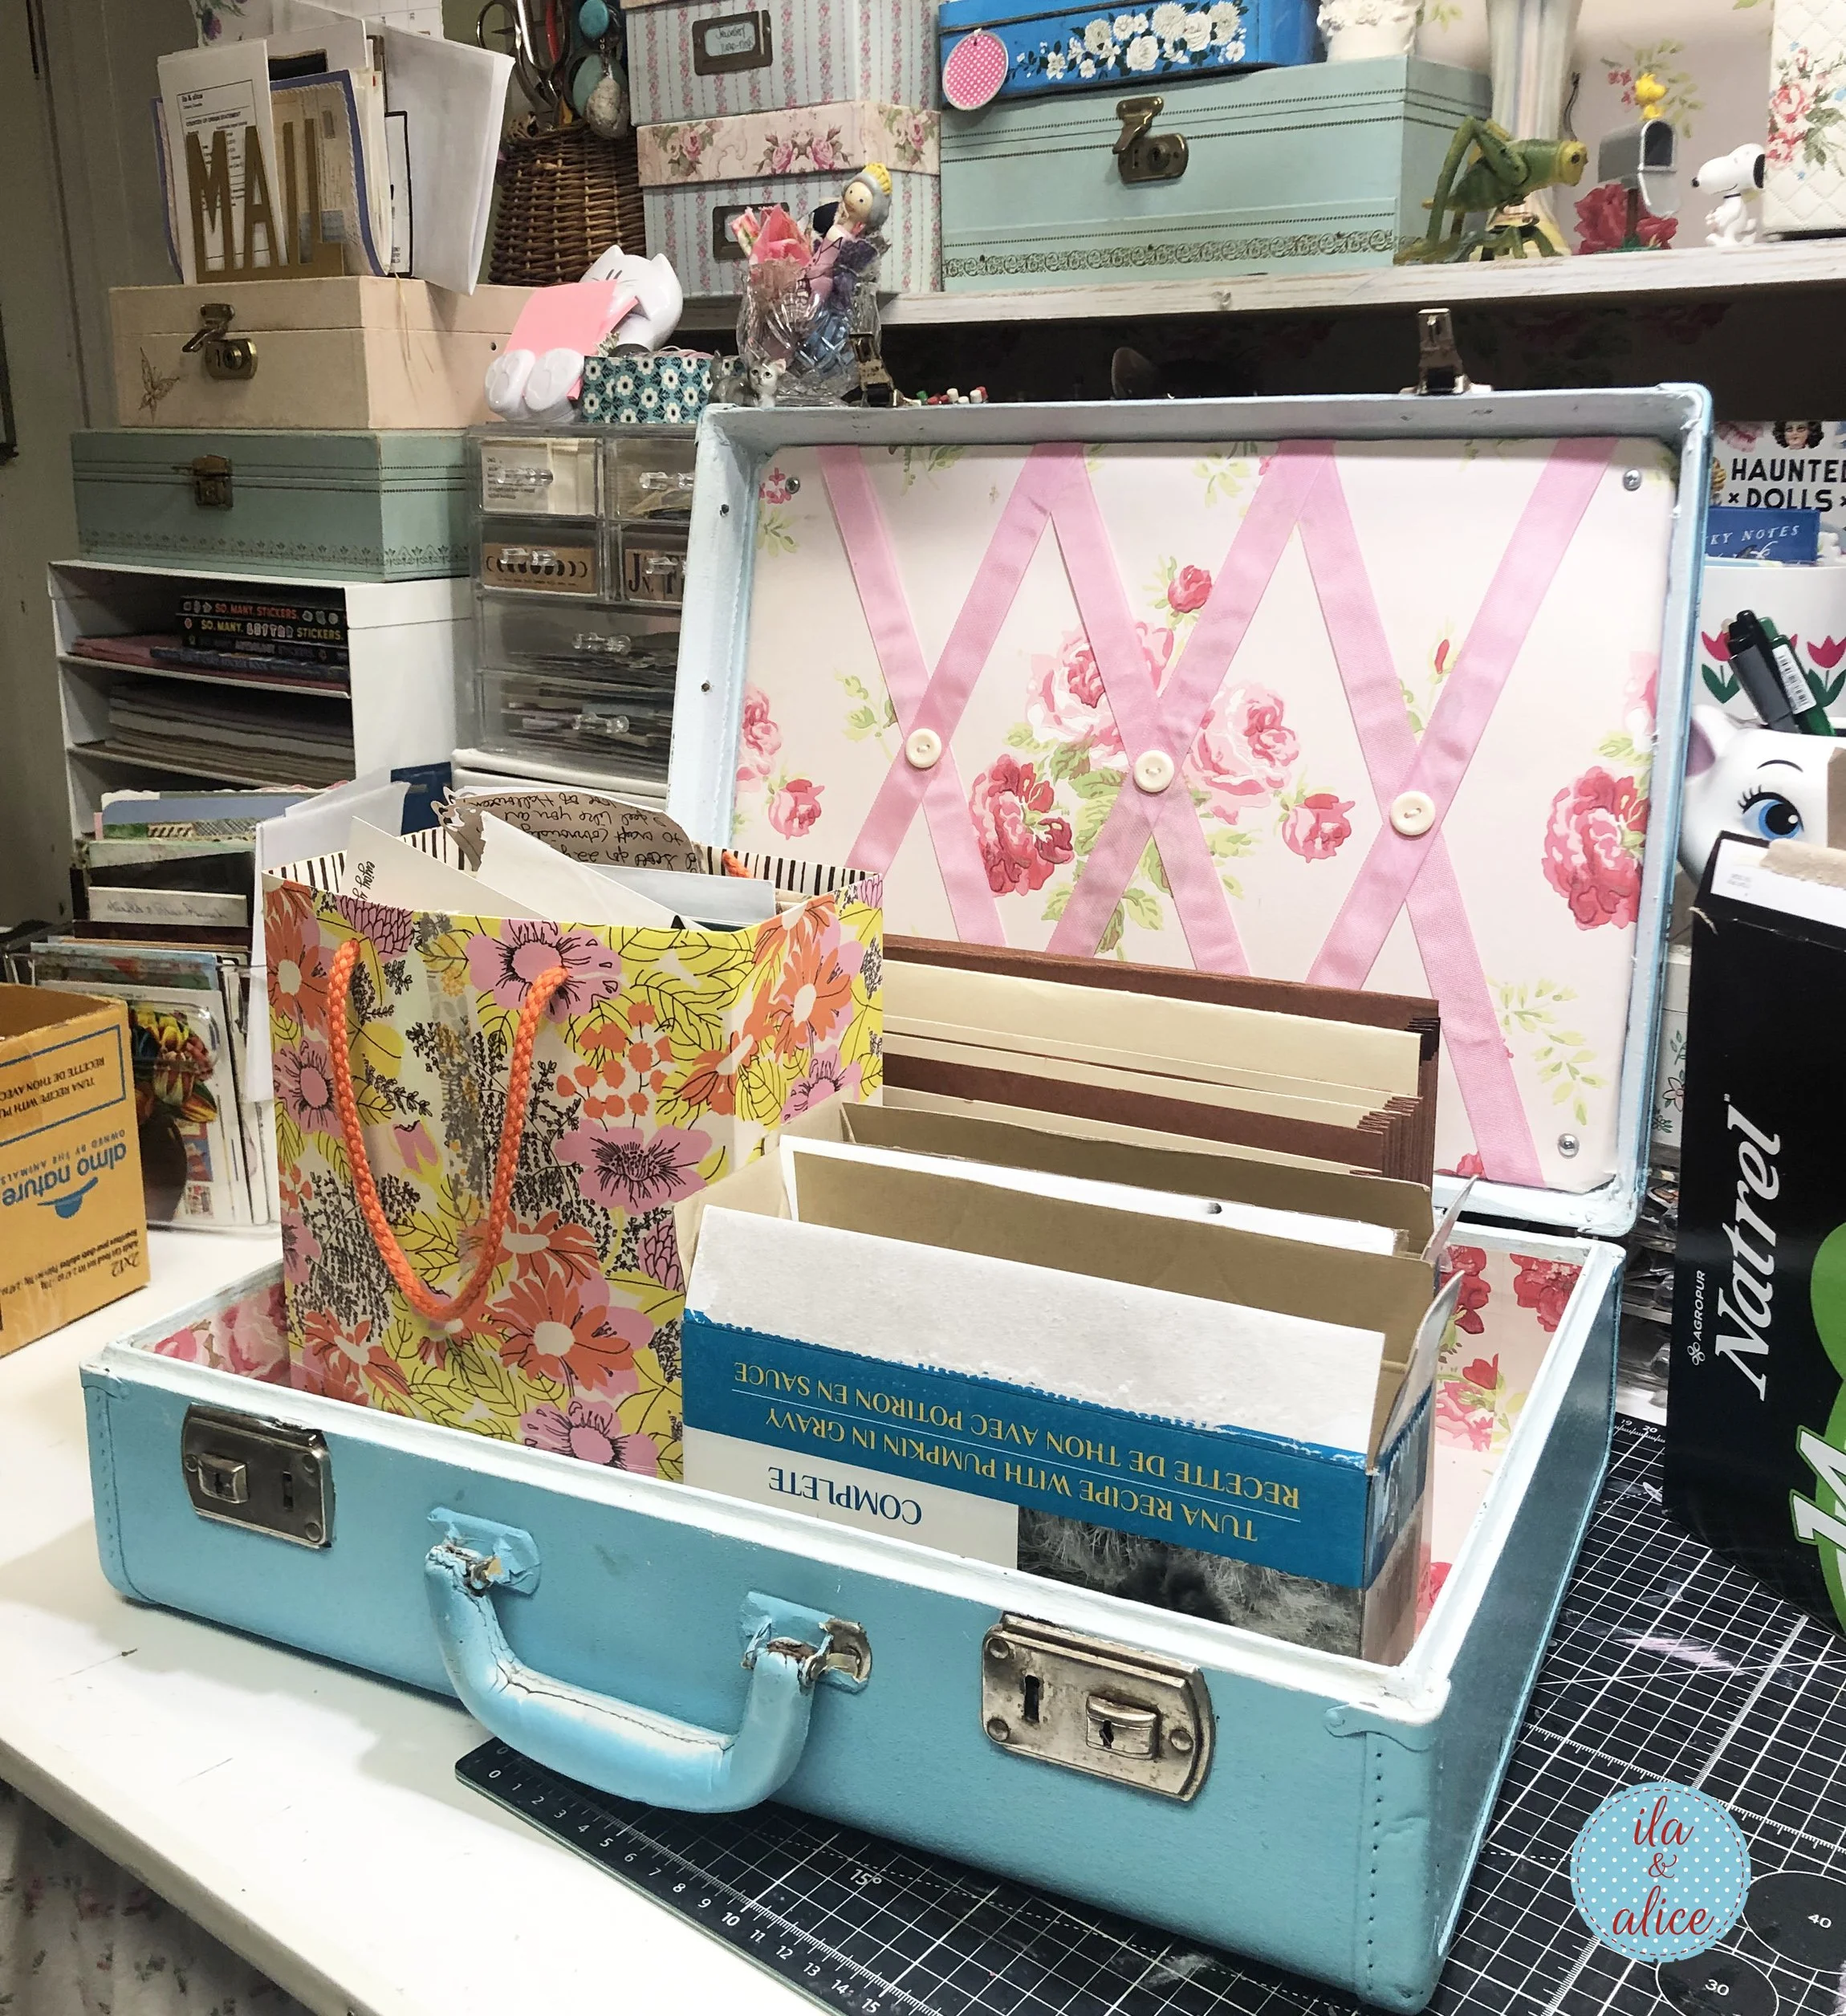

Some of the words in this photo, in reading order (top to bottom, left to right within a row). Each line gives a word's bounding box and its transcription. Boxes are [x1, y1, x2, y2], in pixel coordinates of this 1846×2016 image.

[185, 118, 344, 284] MAIL
[1746, 488, 1833, 512] DOLLS
[1709, 531, 1734, 546] KY
[1741, 525, 1800, 542] NOTES
[201, 619, 216, 631] SO.
[218, 621, 243, 633] MANY.
[296, 627, 344, 641] STICKERS.
[533, 806, 572, 821] you
[579, 811, 612, 827] like
[621, 810, 649, 826] feel
[614, 826, 653, 843] craft
[662, 831, 684, 846] to
[605, 845, 629, 864] for
[355, 861, 376, 890] enjoy
[54, 1071, 66, 1083] DE
[67, 1056, 104, 1078] RECETTE
[27, 1076, 51, 1091] THON
[42, 1086, 71, 1104] RECIPE
[72, 1077, 96, 1092] TUNA
[14, 1098, 38, 1113] WITH
[75, 1144, 87, 1154] BY
[91, 1129, 125, 1148] OWNED
[52, 1151, 71, 1164] THE
[76, 1142, 127, 1177] almo
[1, 1160, 47, 1185] ANIMALS
[2, 1164, 71, 1206] nature
[1715, 1104, 1781, 1401] Natrel
[1696, 1270, 1706, 1341] AGROPUR
[734, 1362, 810, 1396] SAUCE
[818, 1380, 848, 1404] EN
[856, 1388, 963, 1431] POTIRON
[766, 1407, 845, 1442] GRAVY
[970, 1413, 1039, 1446] AVEC
[1642, 1425, 1658, 1433] 20
[852, 1426, 875, 1451] IN
[1046, 1431, 1121, 1468] THON
[884, 1433, 997, 1479] PUMPKIN
[1128, 1449, 1165, 1477] DE
[1005, 1461, 1072, 1498] WITH
[1173, 1461, 1300, 1510] RECETTE
[768, 1466, 923, 1526] COMPLETE
[1079, 1479, 1173, 1522] RECIPE
[1180, 1503, 1258, 1542] TUNA
[849, 1868, 882, 1886] 15°
[489, 1770, 502, 1778] 0
[512, 1782, 522, 1791] 1
[531, 1795, 545, 1805] 2
[553, 1809, 567, 1819] 3
[577, 1823, 590, 1834] 4
[600, 1837, 613, 1847] 5
[624, 1852, 637, 1863] 6
[649, 1867, 661, 1876] 7
[673, 1883, 686, 1893] 8
[697, 1898, 711, 1908] 9
[721, 1912, 740, 1926] 10
[750, 1929, 766, 1943] 11
[775, 1945, 794, 1960] 12
[803, 1962, 821, 1977] 13
[832, 1979, 849, 1994] 14
[861, 1998, 880, 2014] 15
[1807, 1912, 1832, 1929] 40
[1705, 1978, 1730, 1996] 30
